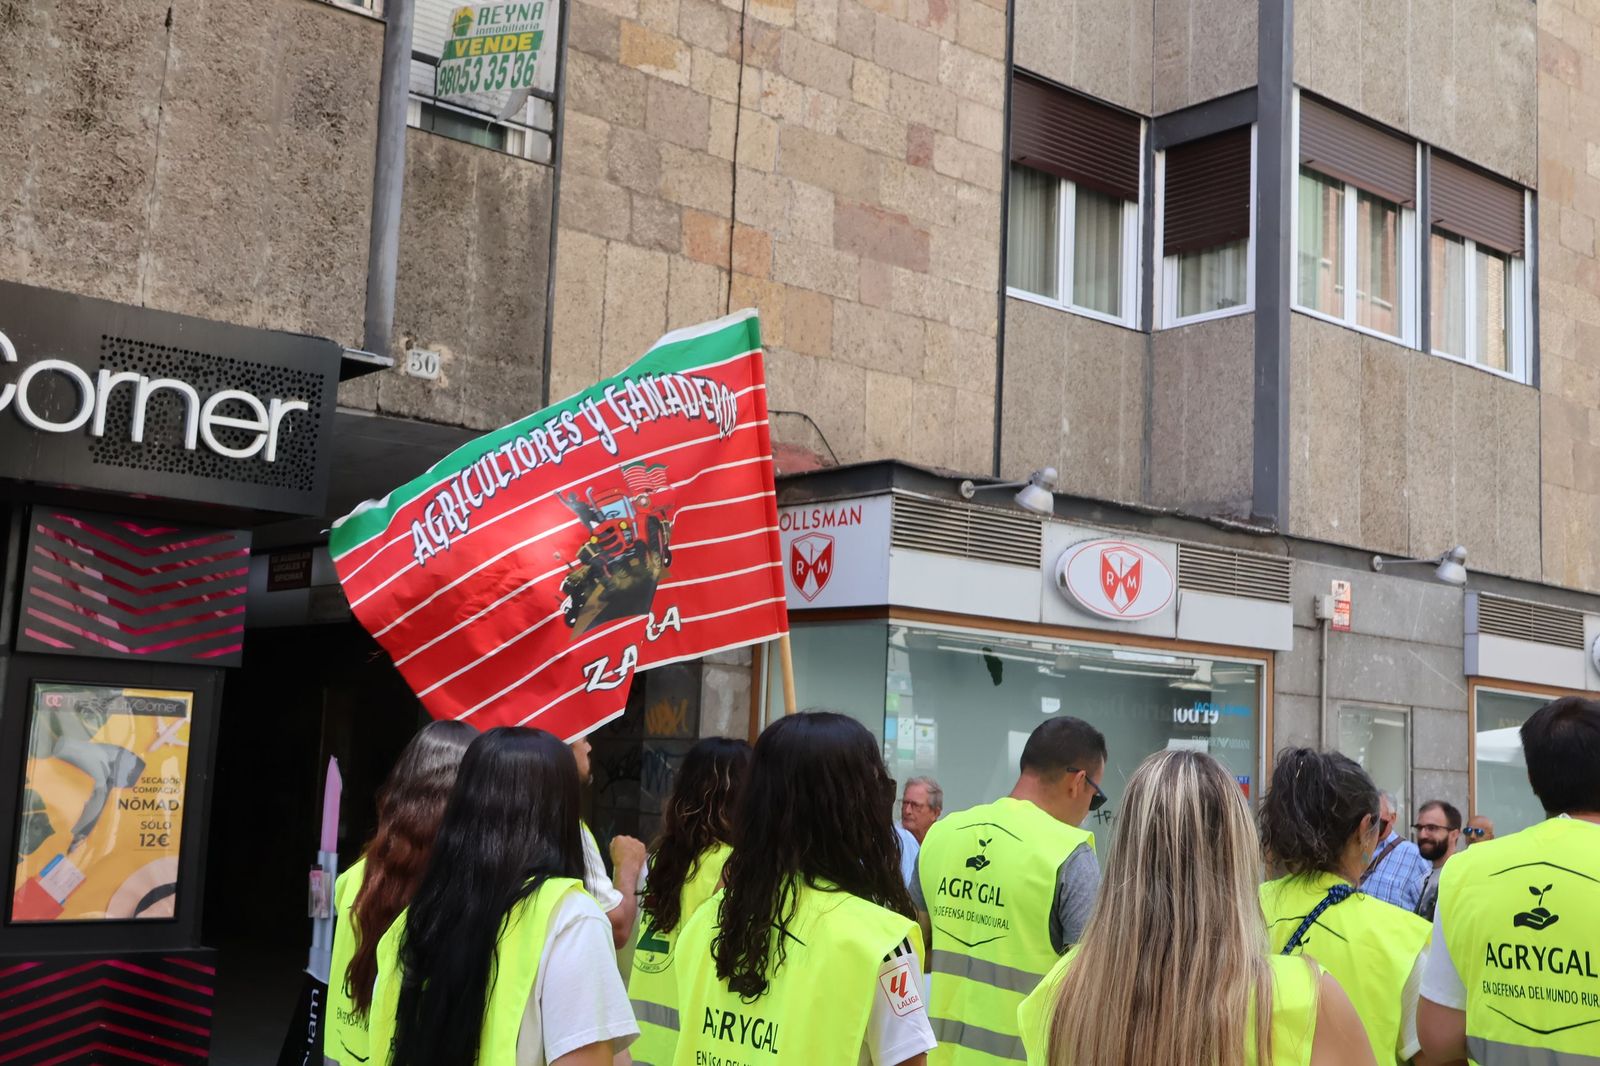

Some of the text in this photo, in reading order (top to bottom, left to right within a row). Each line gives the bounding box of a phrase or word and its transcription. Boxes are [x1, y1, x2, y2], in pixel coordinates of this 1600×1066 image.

[478, 1, 545, 26] REYNA
[454, 32, 534, 57] VENDE
[0, 330, 309, 462] orner
[410, 410, 584, 567] AGRICULTORES
[779, 505, 863, 531] OLLSMAN
[1106, 571, 1138, 589] R M
[139, 832, 170, 848] 12€
[938, 877, 1005, 908] AGRGAL
[1485, 942, 1599, 979] AGRYGAL
[896, 995, 920, 1010] LALIGA
[1491, 982, 1526, 999] DEFENSA
[1528, 985, 1545, 1000] DEL
[1581, 991, 1600, 1008] RUR
